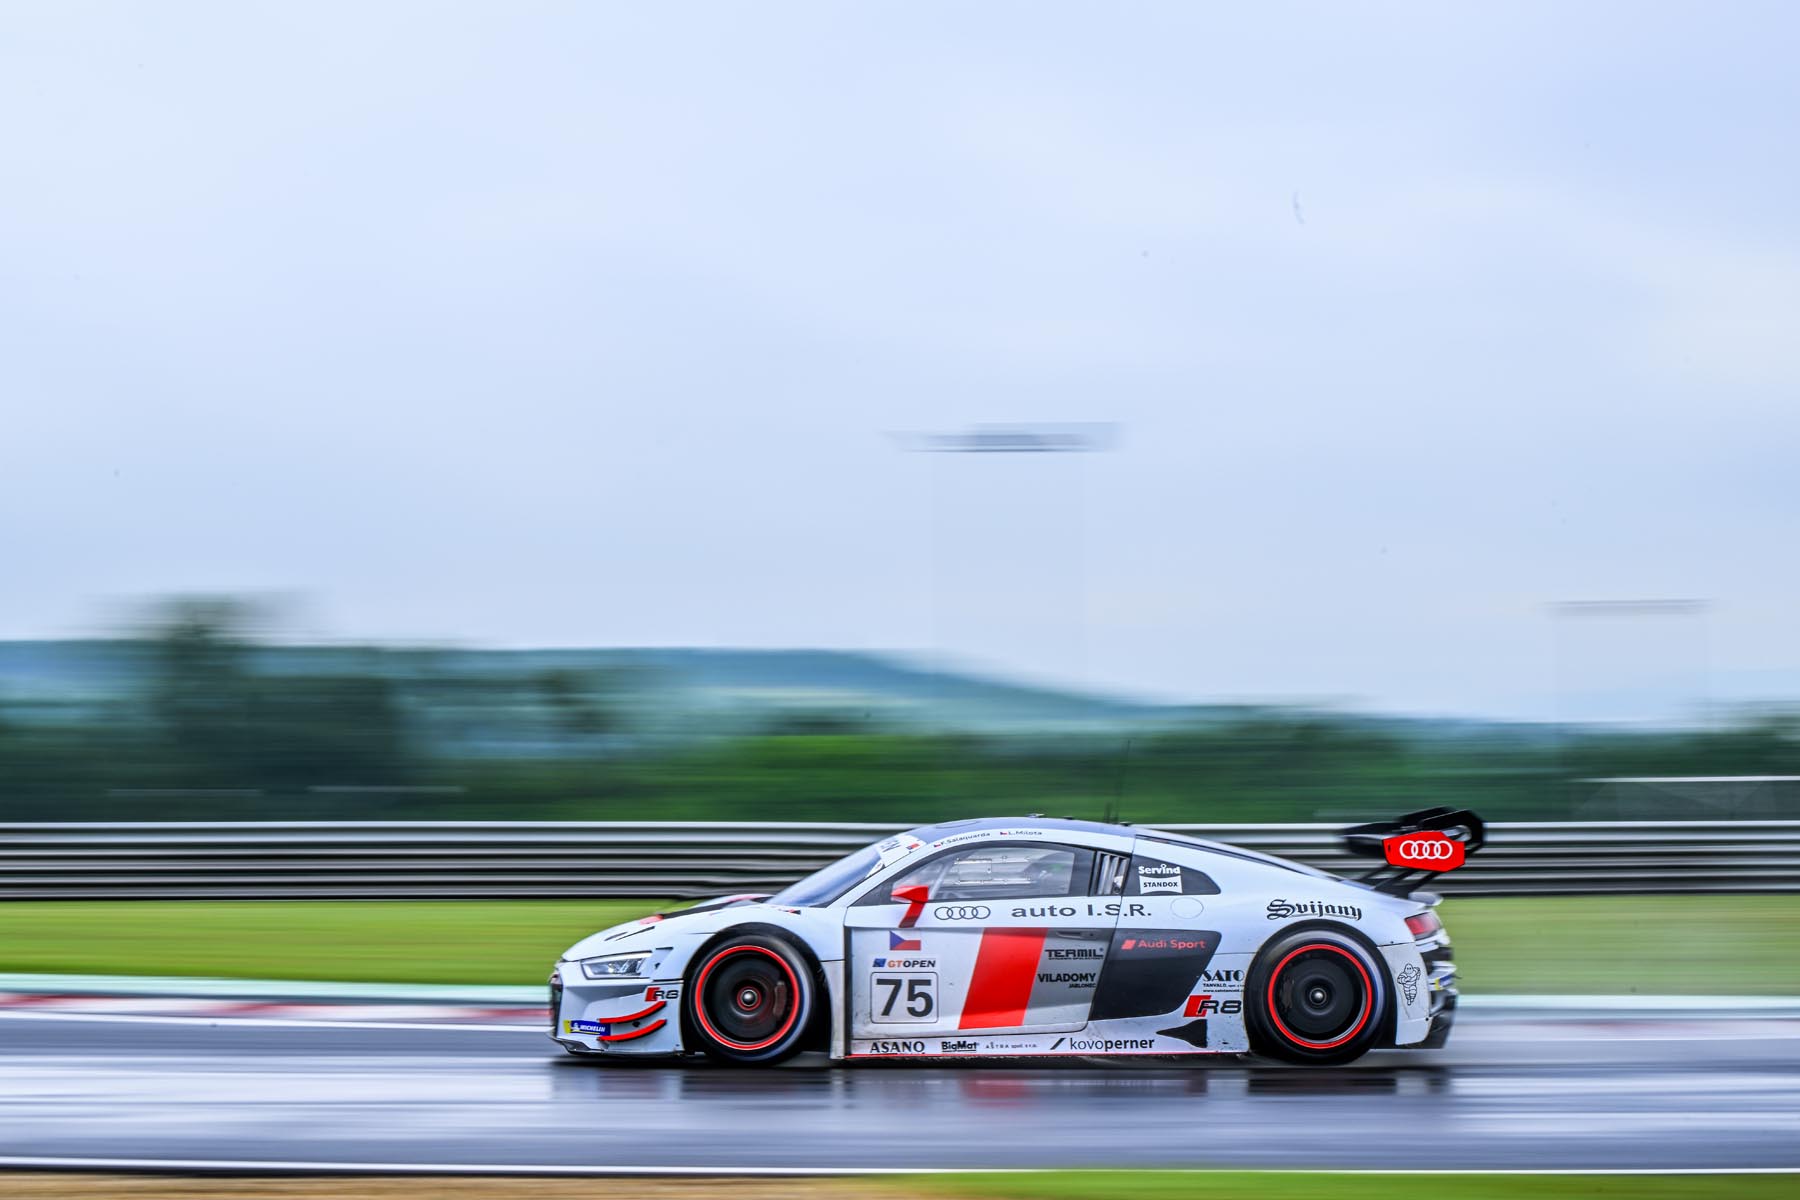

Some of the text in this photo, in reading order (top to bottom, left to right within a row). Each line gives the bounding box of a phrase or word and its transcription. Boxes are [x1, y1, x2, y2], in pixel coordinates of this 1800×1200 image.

[1138, 863, 1181, 874] Servind
[1011, 903, 1152, 918] auto I.S.R.
[1266, 899, 1363, 921] Svijany
[1138, 939, 1206, 949] Audi Sport
[1045, 948, 1104, 958] TERMIL
[1037, 973, 1096, 983] VILADOMY
[1203, 969, 1245, 982] SATO
[653, 989, 679, 1000] R8
[875, 978, 933, 1018] 75
[1197, 1000, 1242, 1014] R8
[869, 1041, 925, 1054] ASANO
[941, 1041, 977, 1052] BigMat
[1070, 1038, 1155, 1051] kovoperner
